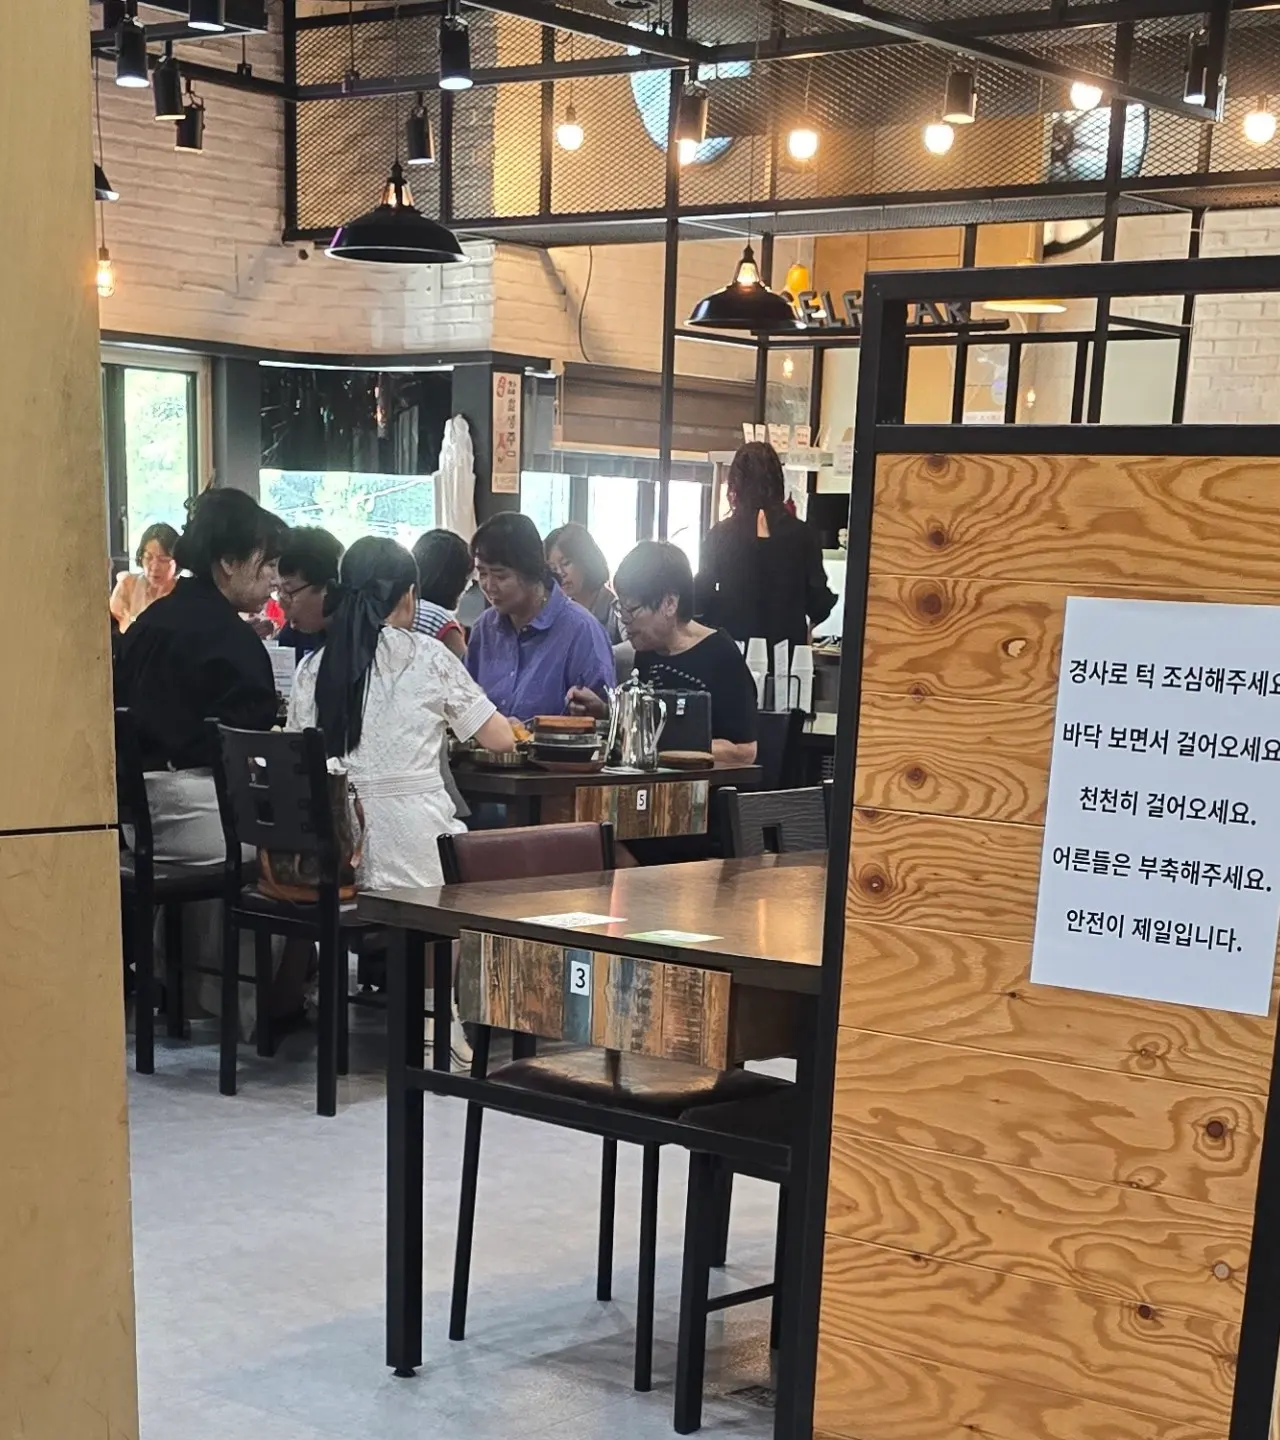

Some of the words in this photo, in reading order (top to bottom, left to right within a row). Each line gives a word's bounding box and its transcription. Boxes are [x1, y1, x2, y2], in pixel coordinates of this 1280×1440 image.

[1069, 659, 1128, 686] 경사로
[1136, 663, 1155, 690] 턱
[1062, 722, 1103, 749] 바닥
[1107, 726, 1169, 755] 보면서
[638, 794, 645, 807] 5
[1079, 786, 1139, 816] 천천히
[1146, 793, 1257, 826] 걸어오세요.
[1053, 846, 1132, 877] 어른들은
[1138, 855, 1272, 893] 부축해주세요.
[1066, 909, 1125, 939] 안전이
[1131, 917, 1242, 953] 제일입니다.
[574, 967, 586, 989] 3
